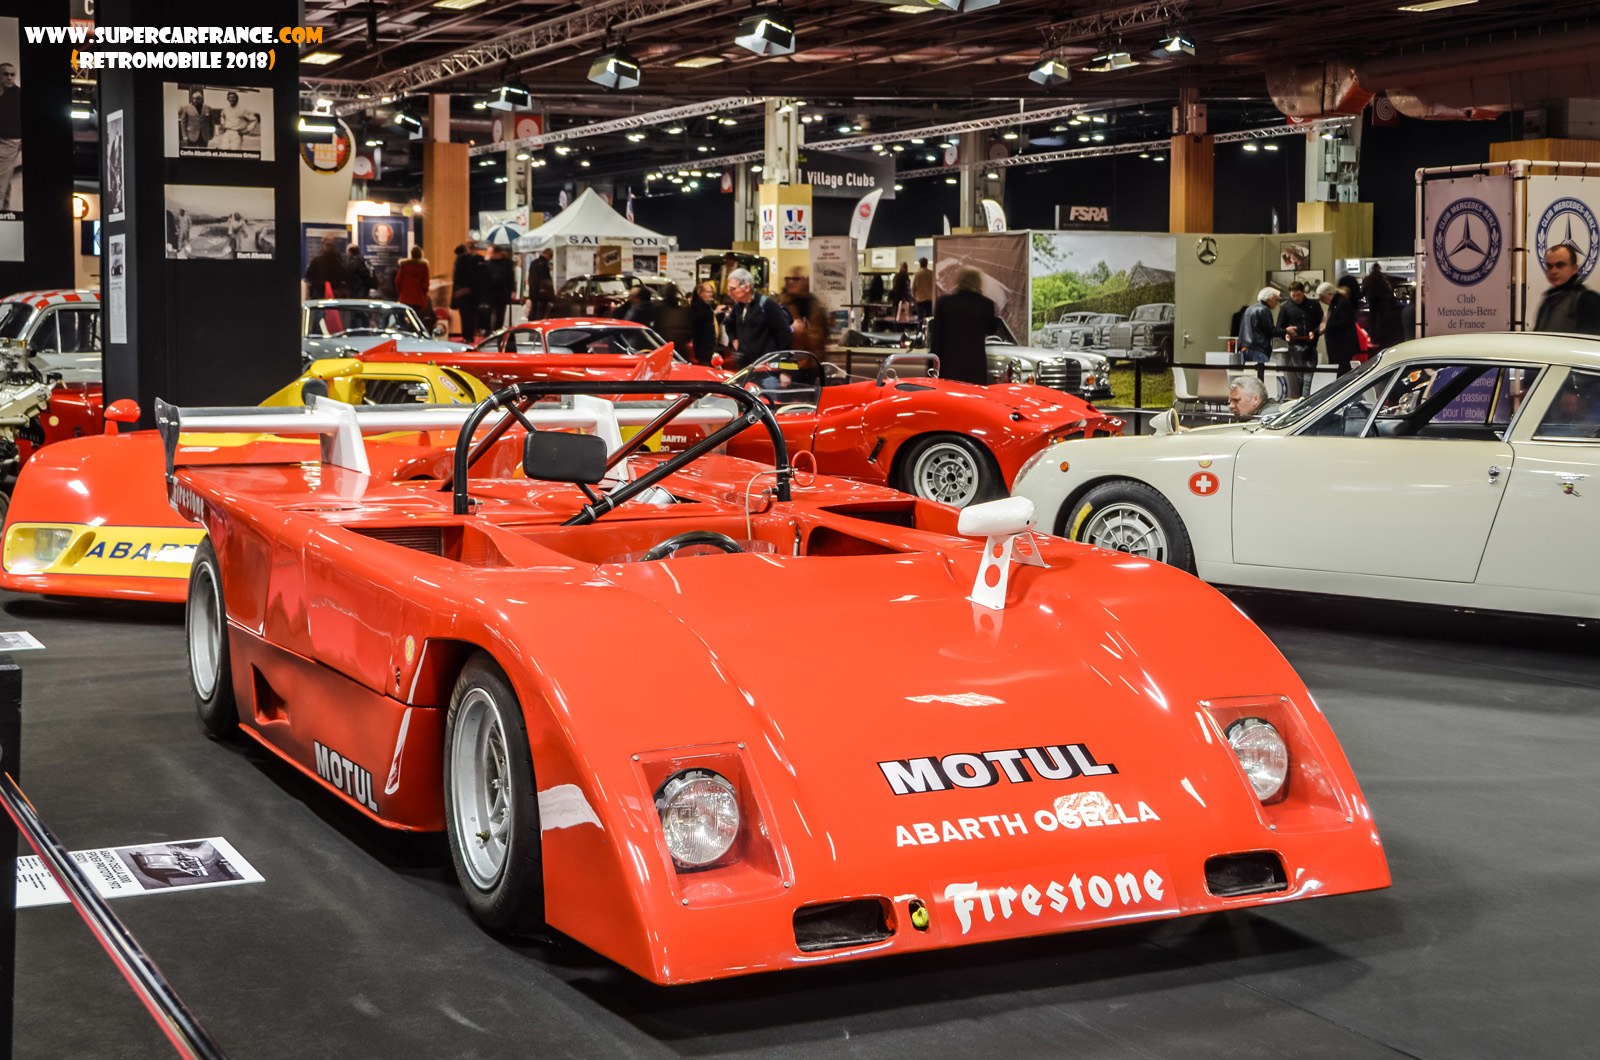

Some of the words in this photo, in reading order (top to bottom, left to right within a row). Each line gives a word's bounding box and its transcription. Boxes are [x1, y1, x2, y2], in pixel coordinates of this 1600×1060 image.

[807, 171, 842, 189] Village
[846, 172, 876, 187] Clubs
[1069, 206, 1108, 222] FSRA
[1439, 212, 1452, 231] CLUB
[1451, 201, 1497, 230] MERCEDES-BENZ
[1541, 210, 1554, 229] CLUB
[1554, 200, 1596, 229] MERCEDES-BENZ
[1452, 273, 1460, 281] DE
[1460, 272, 1482, 283] FRANCE
[1457, 294, 1476, 304] Club
[1437, 307, 1497, 317] Mercedes-Benz
[1448, 320, 1458, 329] de
[1460, 320, 1486, 329] France
[1462, 393, 1490, 403] passion
[1443, 408, 1459, 419] pour
[1461, 407, 1485, 418] l'étoile
[661, 435, 687, 443] BARTH
[313, 739, 380, 815] MOTUL
[877, 743, 1119, 795] MOTUL
[896, 813, 1029, 847] ABARTH
[1033, 801, 1161, 834] OSELLA
[944, 869, 1164, 935] Firestone
